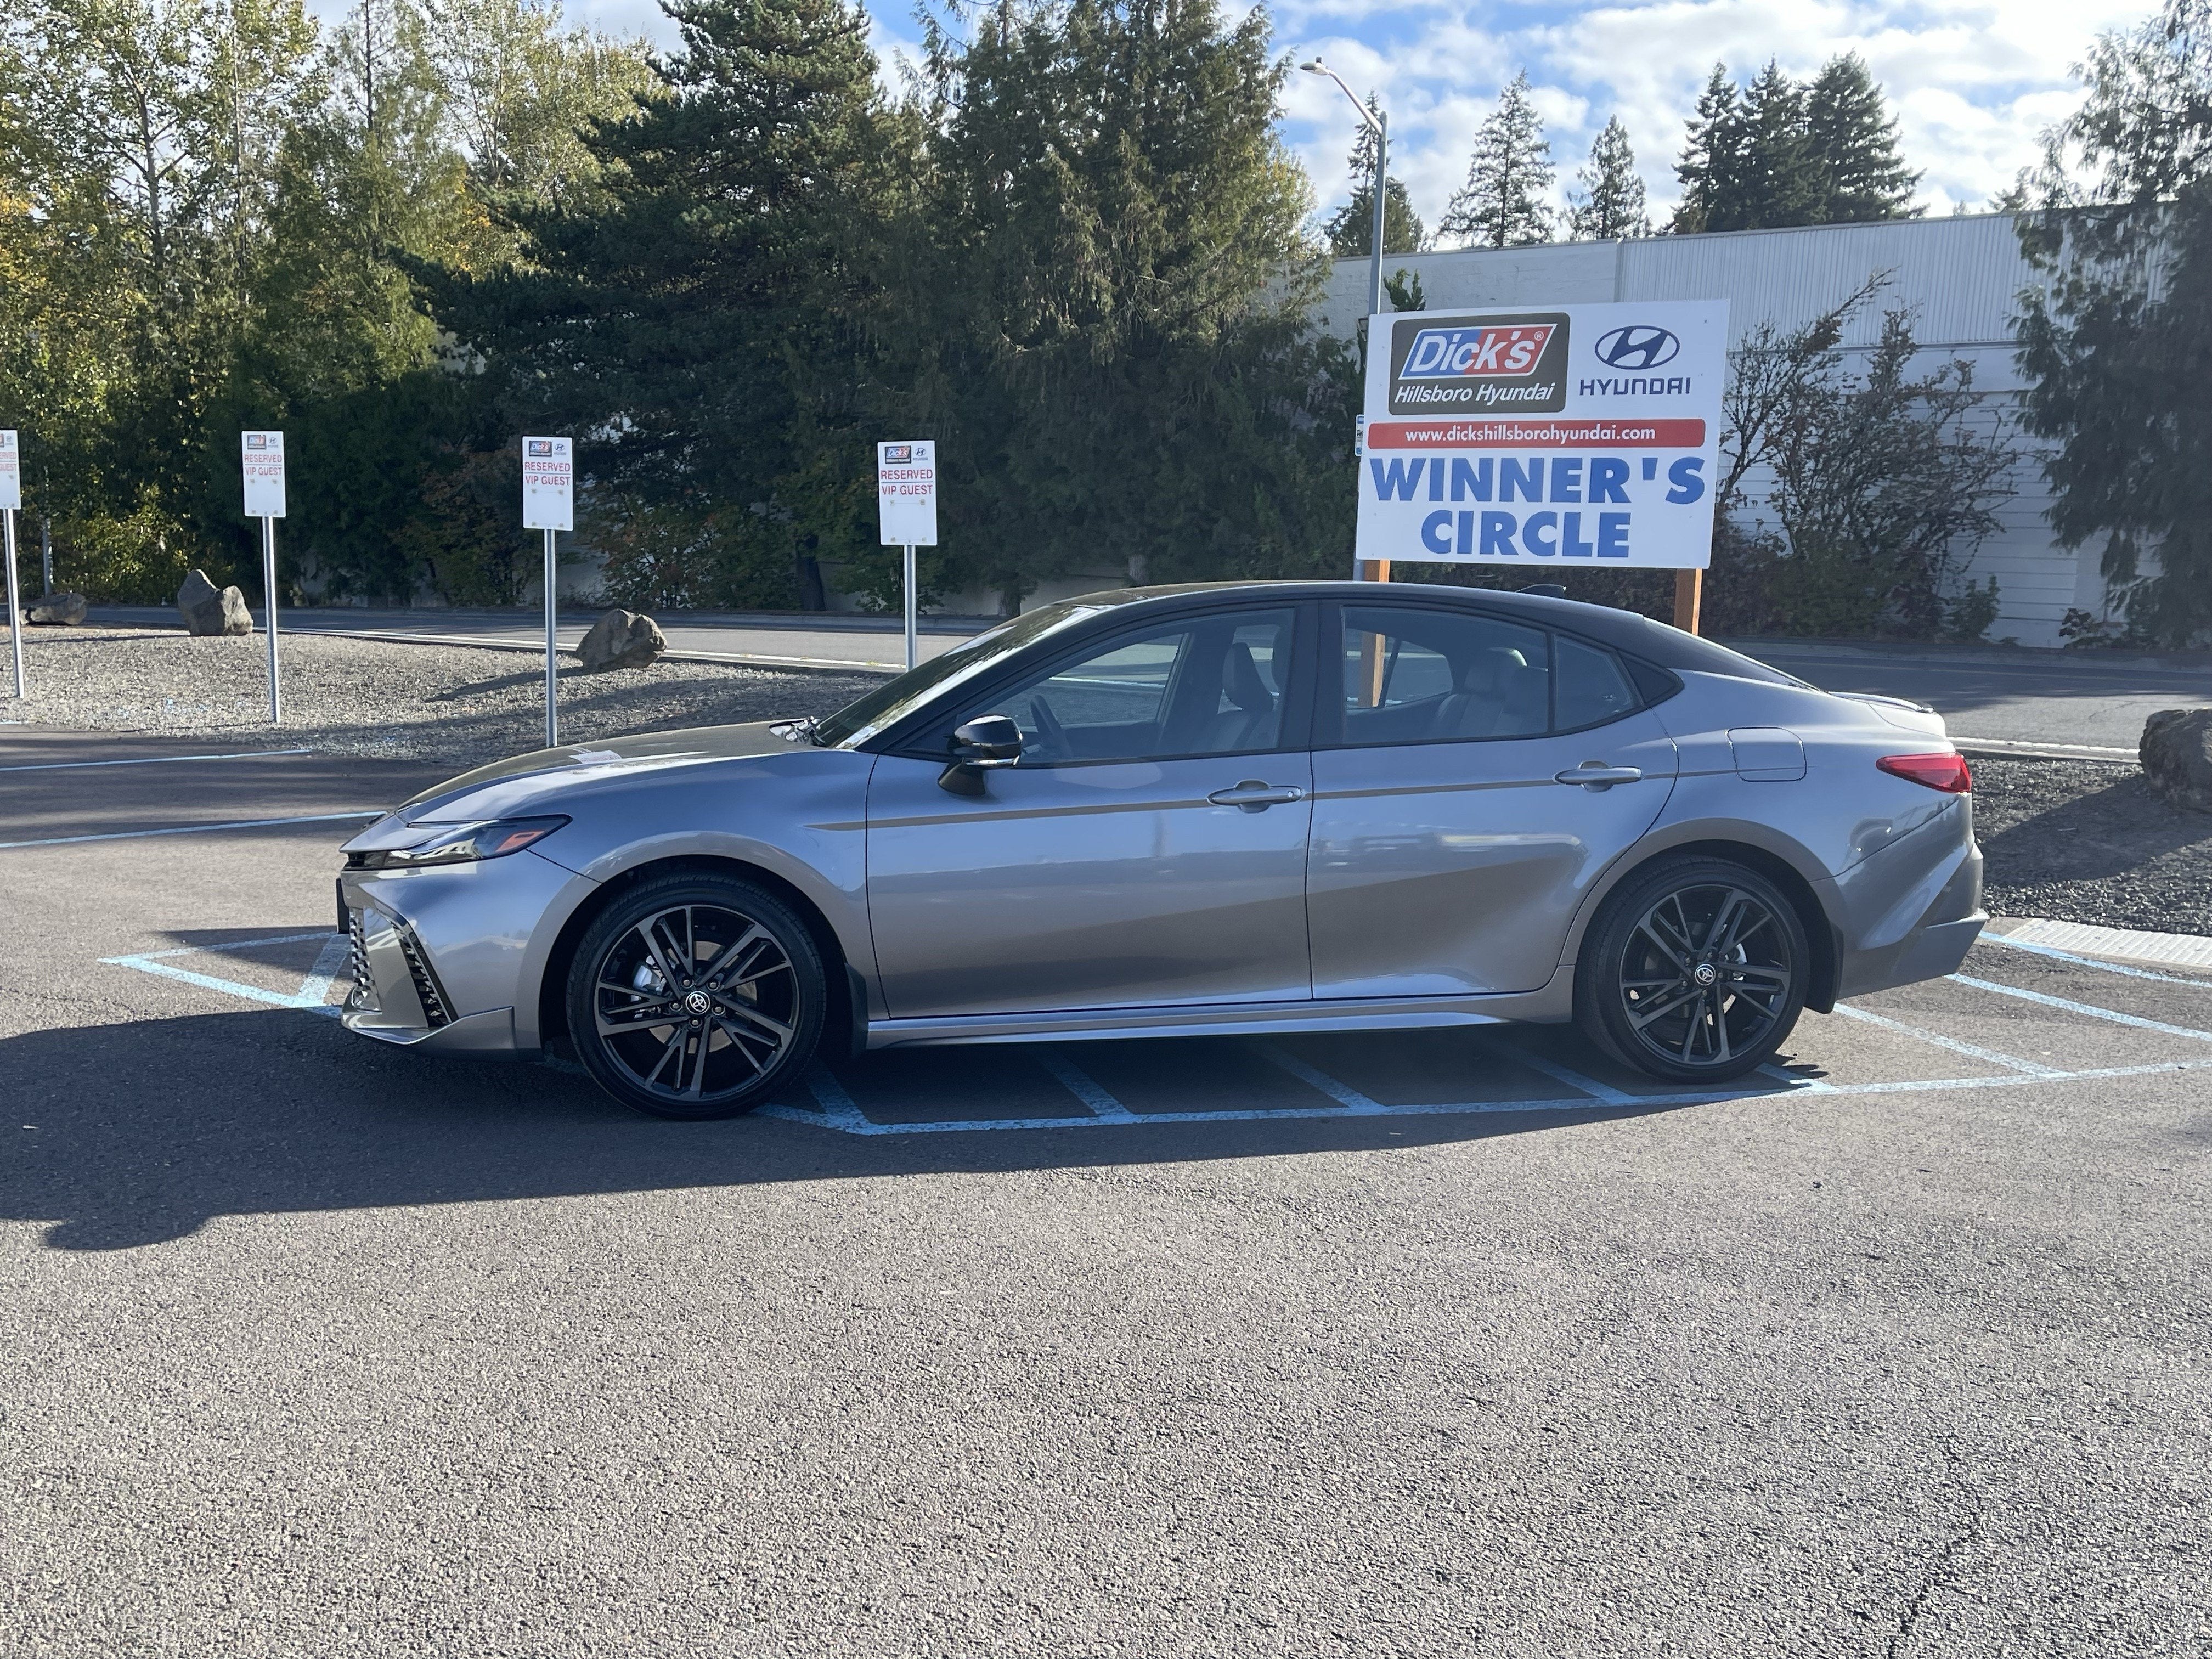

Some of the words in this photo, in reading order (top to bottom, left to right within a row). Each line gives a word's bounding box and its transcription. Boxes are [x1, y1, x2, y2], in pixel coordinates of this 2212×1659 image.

[1410, 331, 1535, 373] Dick's
[1394, 386, 1474, 404] Hillsboro
[1475, 382, 1555, 406] Hyundai
[1579, 377, 1691, 396] HYUNDAI
[1406, 424, 1656, 444] www.dickshillsborohyundai.com
[244, 454, 282, 462] RESERVED
[245, 467, 256, 475] VIP
[258, 467, 282, 476] GUEST
[524, 461, 571, 471] RESERVED
[525, 475, 539, 484] VIP
[541, 476, 571, 486] GUEST
[881, 469, 933, 479] RESERVED
[1370, 457, 1705, 505] WINNER'S
[882, 485, 896, 495] VIP
[900, 484, 933, 495] GUEST
[1421, 510, 1631, 558] CIRCLE
